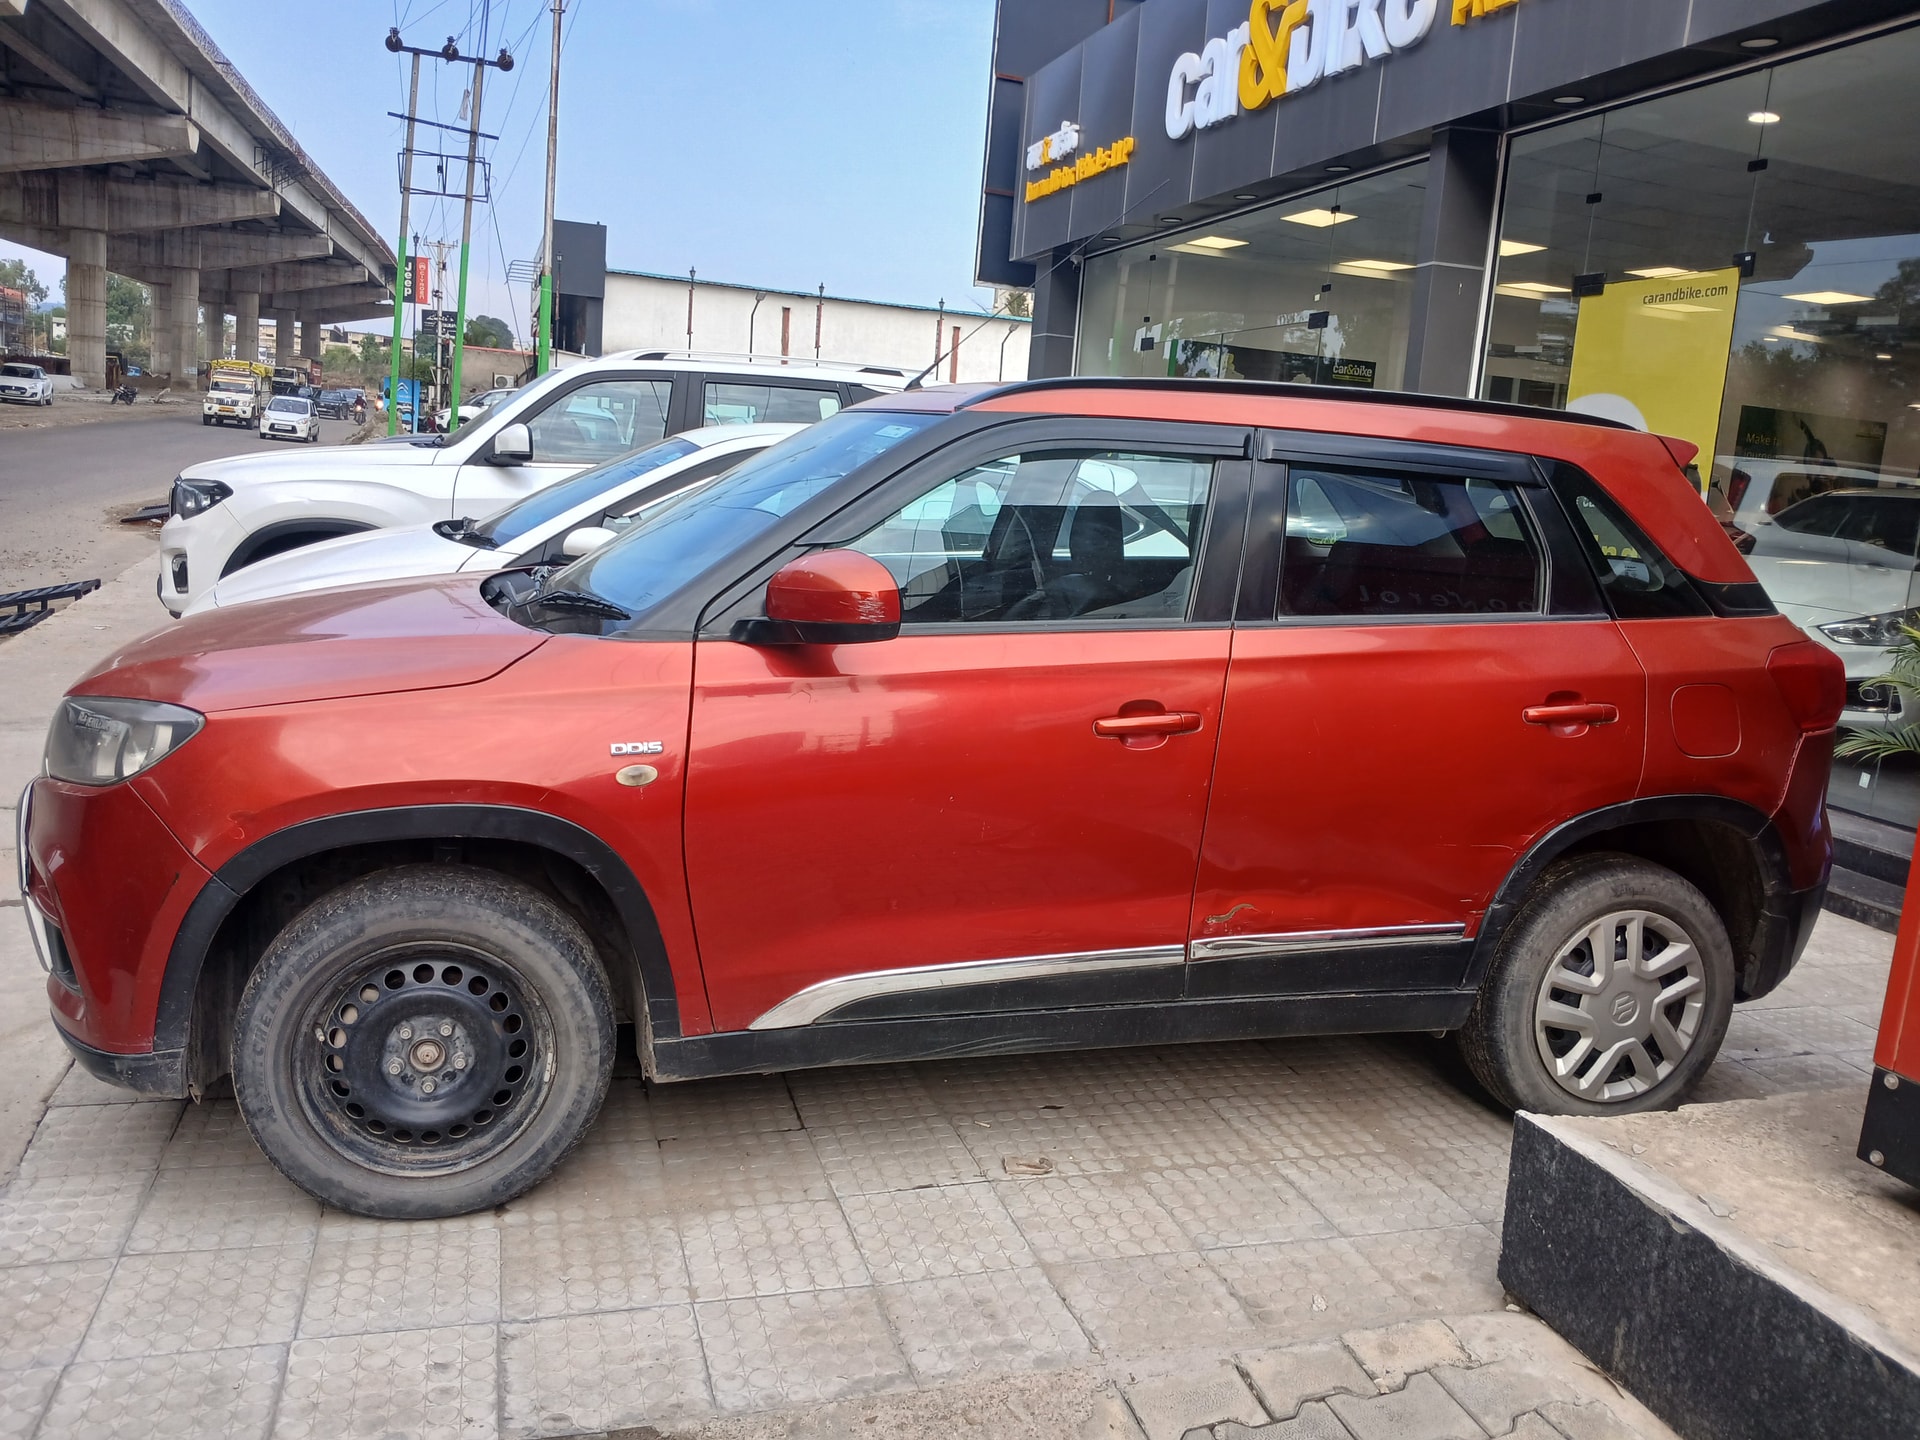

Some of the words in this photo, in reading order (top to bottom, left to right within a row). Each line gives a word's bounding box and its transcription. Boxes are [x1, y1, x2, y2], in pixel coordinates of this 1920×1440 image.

[404, 262, 412, 297] Jeep
[1643, 285, 1728, 305] carandbike.com
[1333, 364, 1372, 377] car&bike
[1746, 433, 1771, 446] Make
